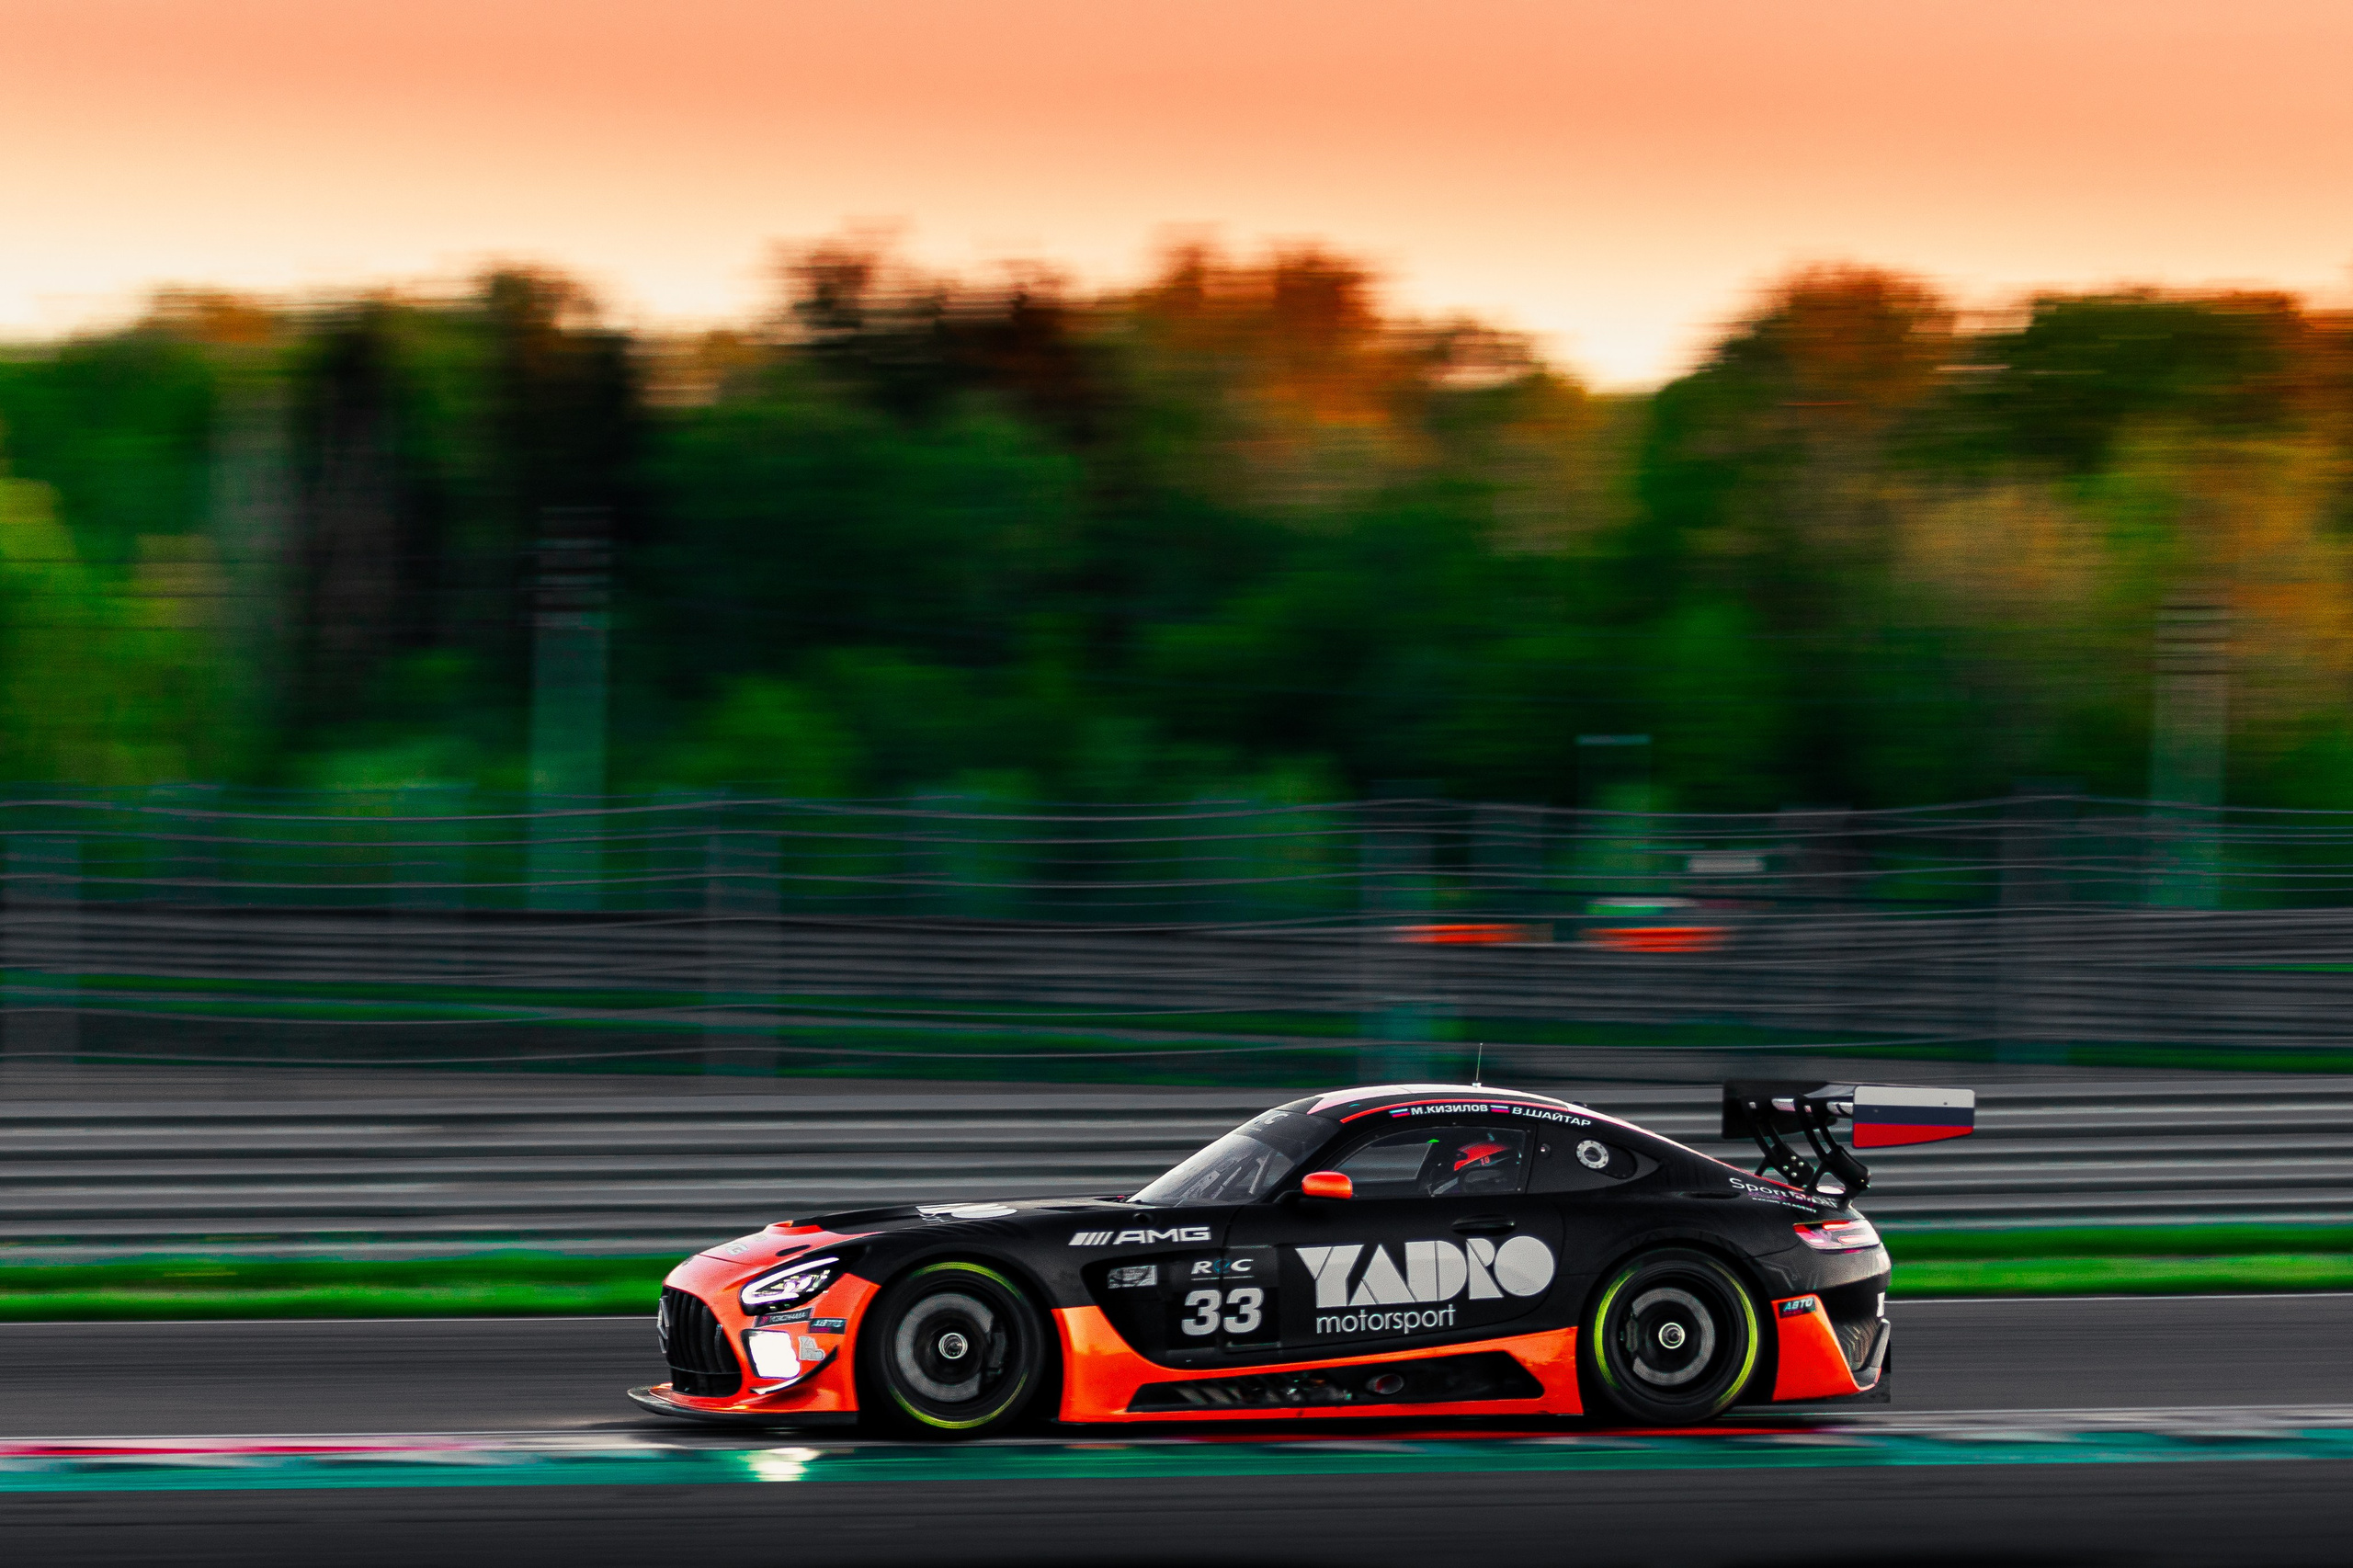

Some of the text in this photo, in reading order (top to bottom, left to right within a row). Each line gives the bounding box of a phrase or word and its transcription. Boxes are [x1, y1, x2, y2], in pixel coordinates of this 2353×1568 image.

[1411, 1104, 1591, 1127] М.КИЗИЛОВ В.ШАЙТАР
[1113, 1226, 1211, 1245] AMG
[1295, 1235, 1554, 1308] YADRO
[1182, 1288, 1265, 1335] 33
[1316, 1303, 1456, 1334] motorsport
